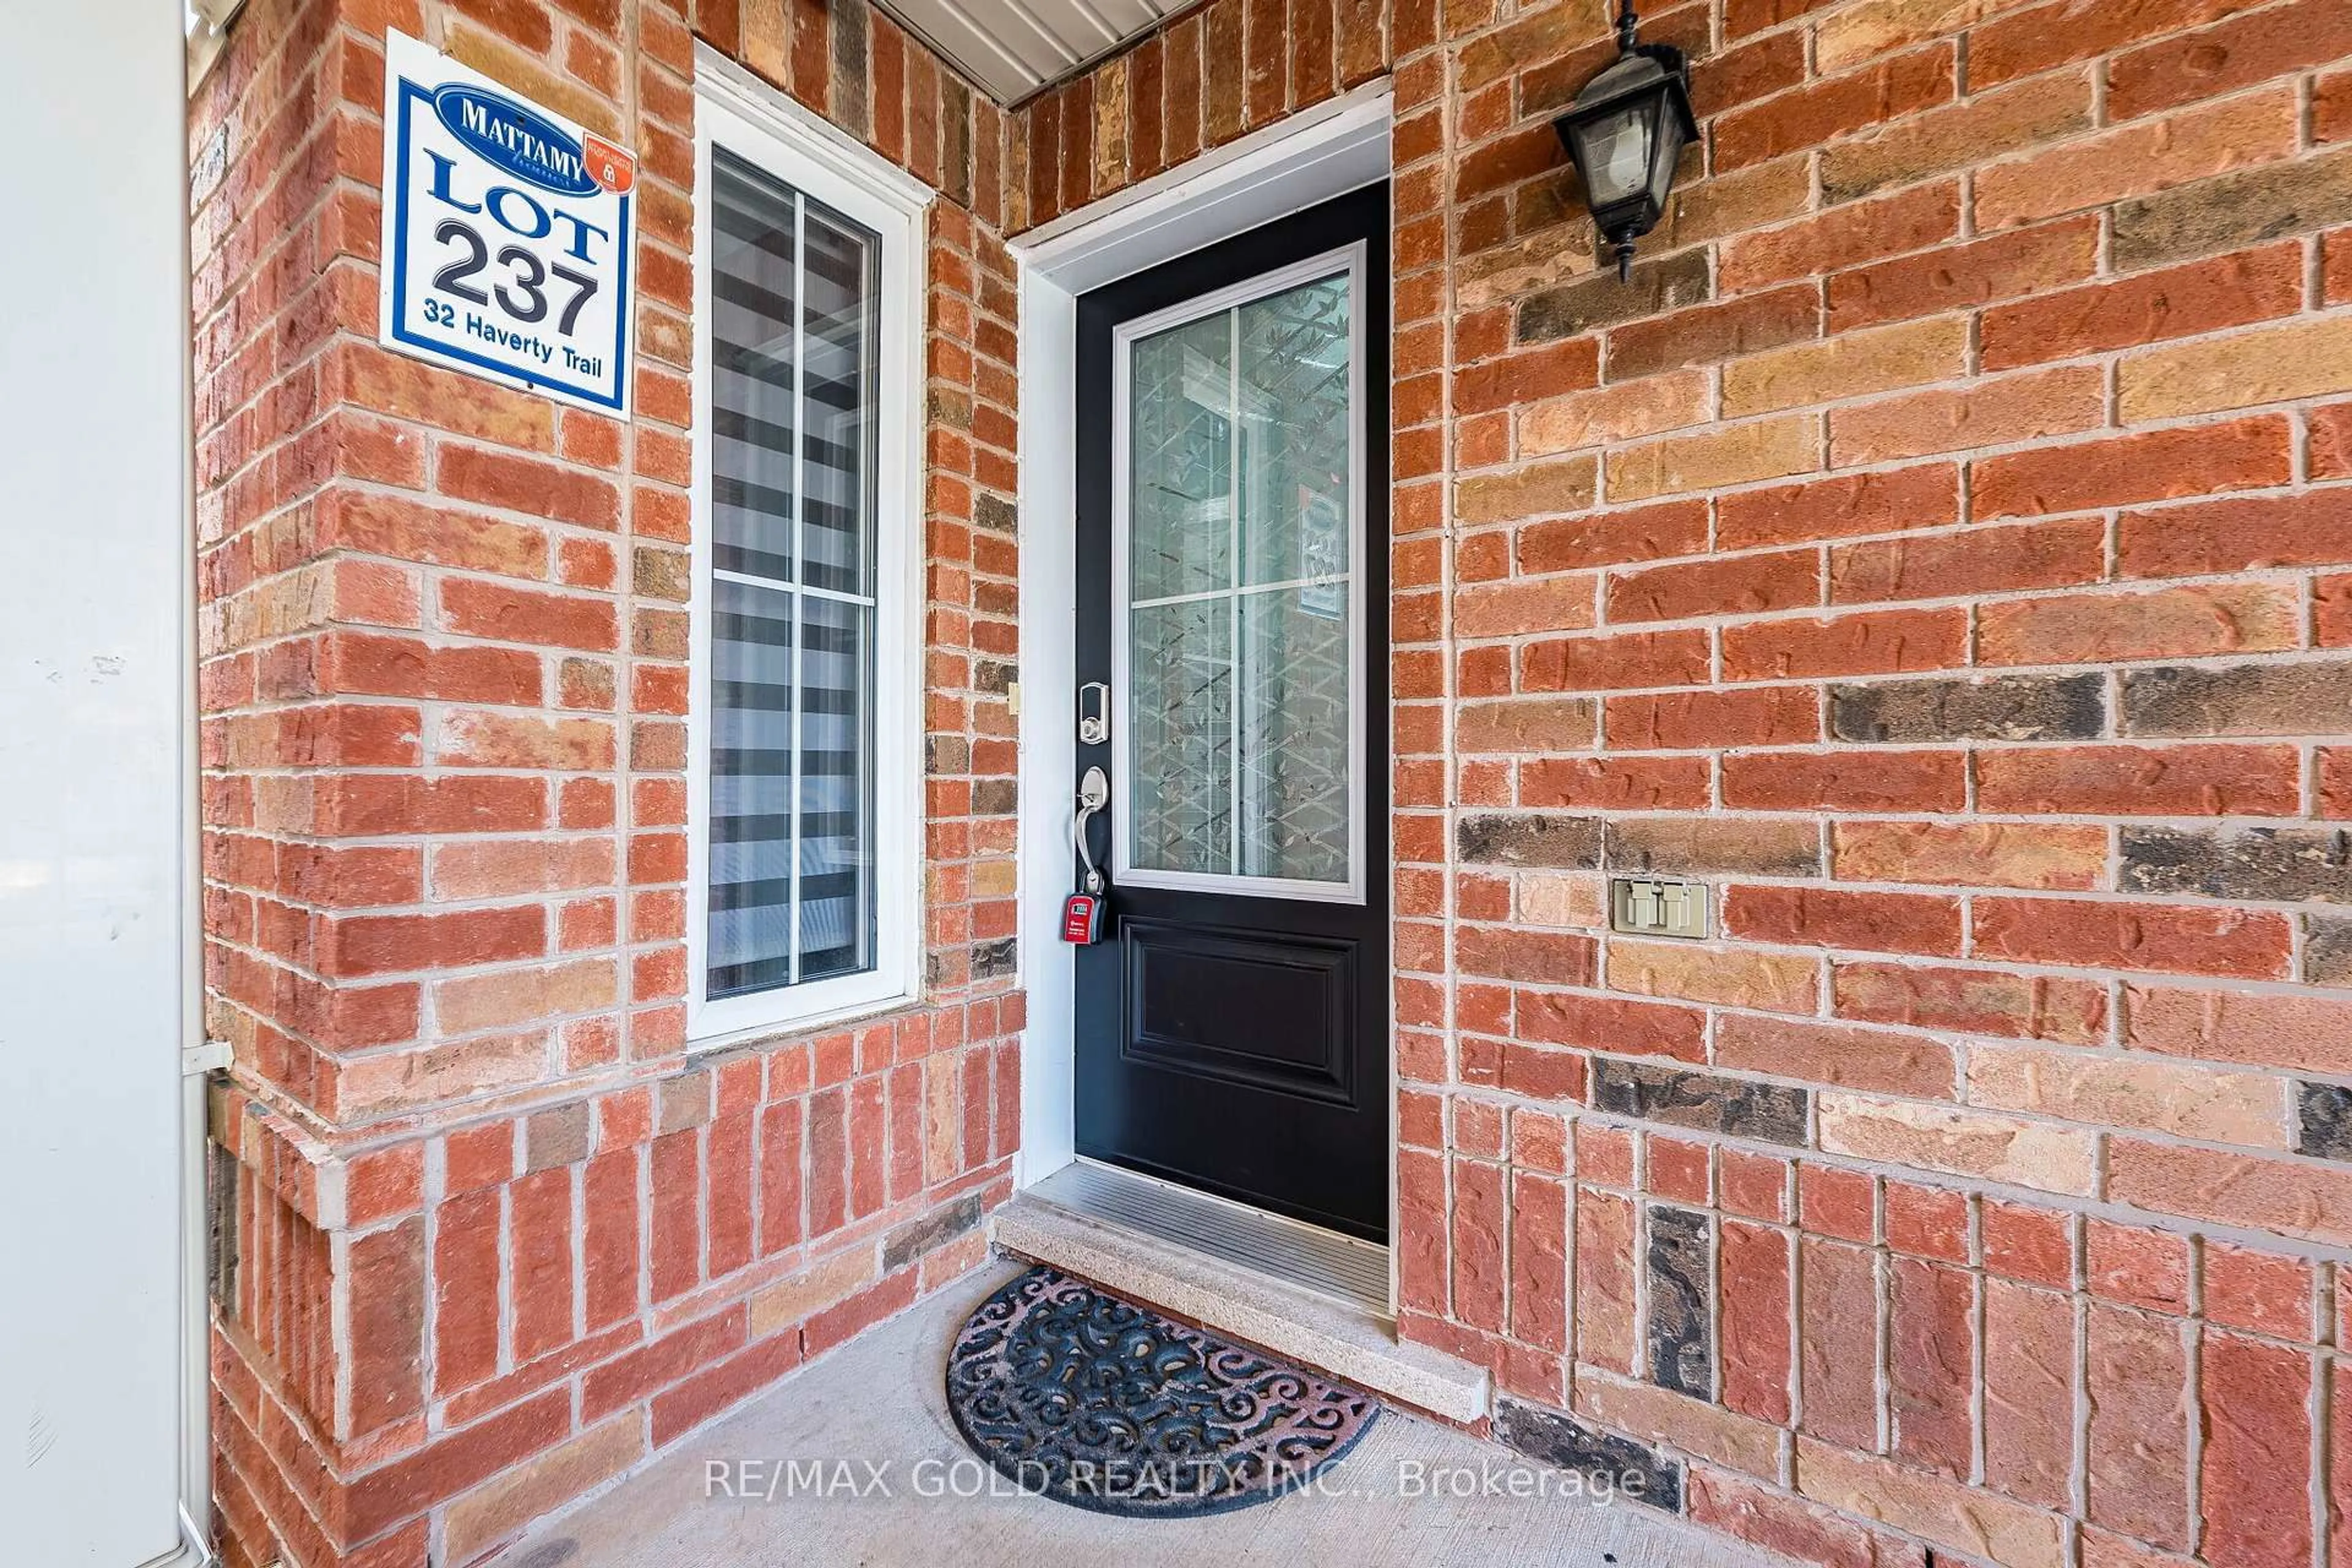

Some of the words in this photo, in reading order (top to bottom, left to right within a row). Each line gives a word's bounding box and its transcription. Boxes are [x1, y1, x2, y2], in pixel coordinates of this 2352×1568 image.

[461, 97, 582, 183] MATTAMY
[423, 147, 608, 265] LOT
[432, 217, 598, 336] 237
[423, 298, 455, 328] 32
[466, 312, 552, 364] Haverty
[562, 345, 601, 378] Trail
